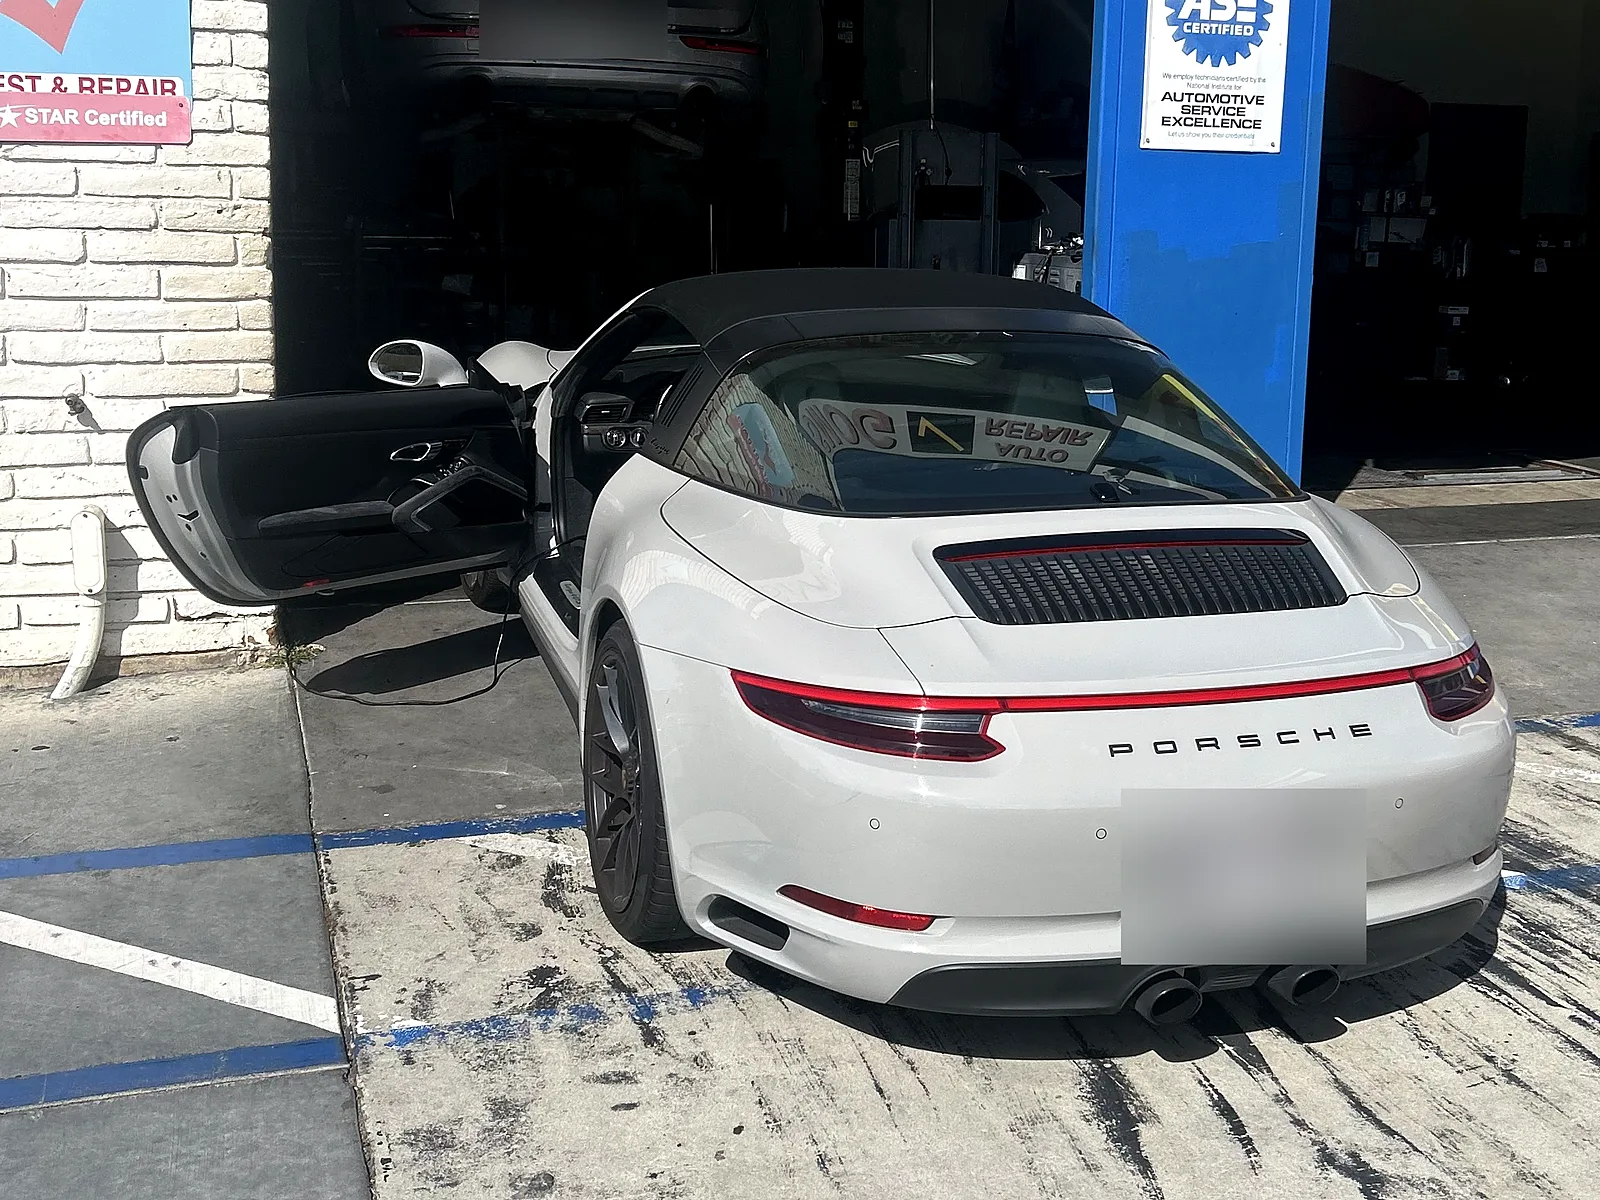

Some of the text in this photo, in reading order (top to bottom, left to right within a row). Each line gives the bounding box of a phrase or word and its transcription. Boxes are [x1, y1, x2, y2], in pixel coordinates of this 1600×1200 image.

[1182, 22, 1254, 36] CERTIFIED
[1162, 72, 1172, 80] We
[52, 76, 68, 93] &
[78, 77, 177, 96] REPAIR
[1161, 92, 1265, 105] AUTOMOTIVE
[24, 107, 167, 127] STAR Certified
[1180, 105, 1246, 117] SERVICE
[1161, 116, 1262, 129] EXCELLENCE
[1108, 723, 1373, 757] PORSCHE
